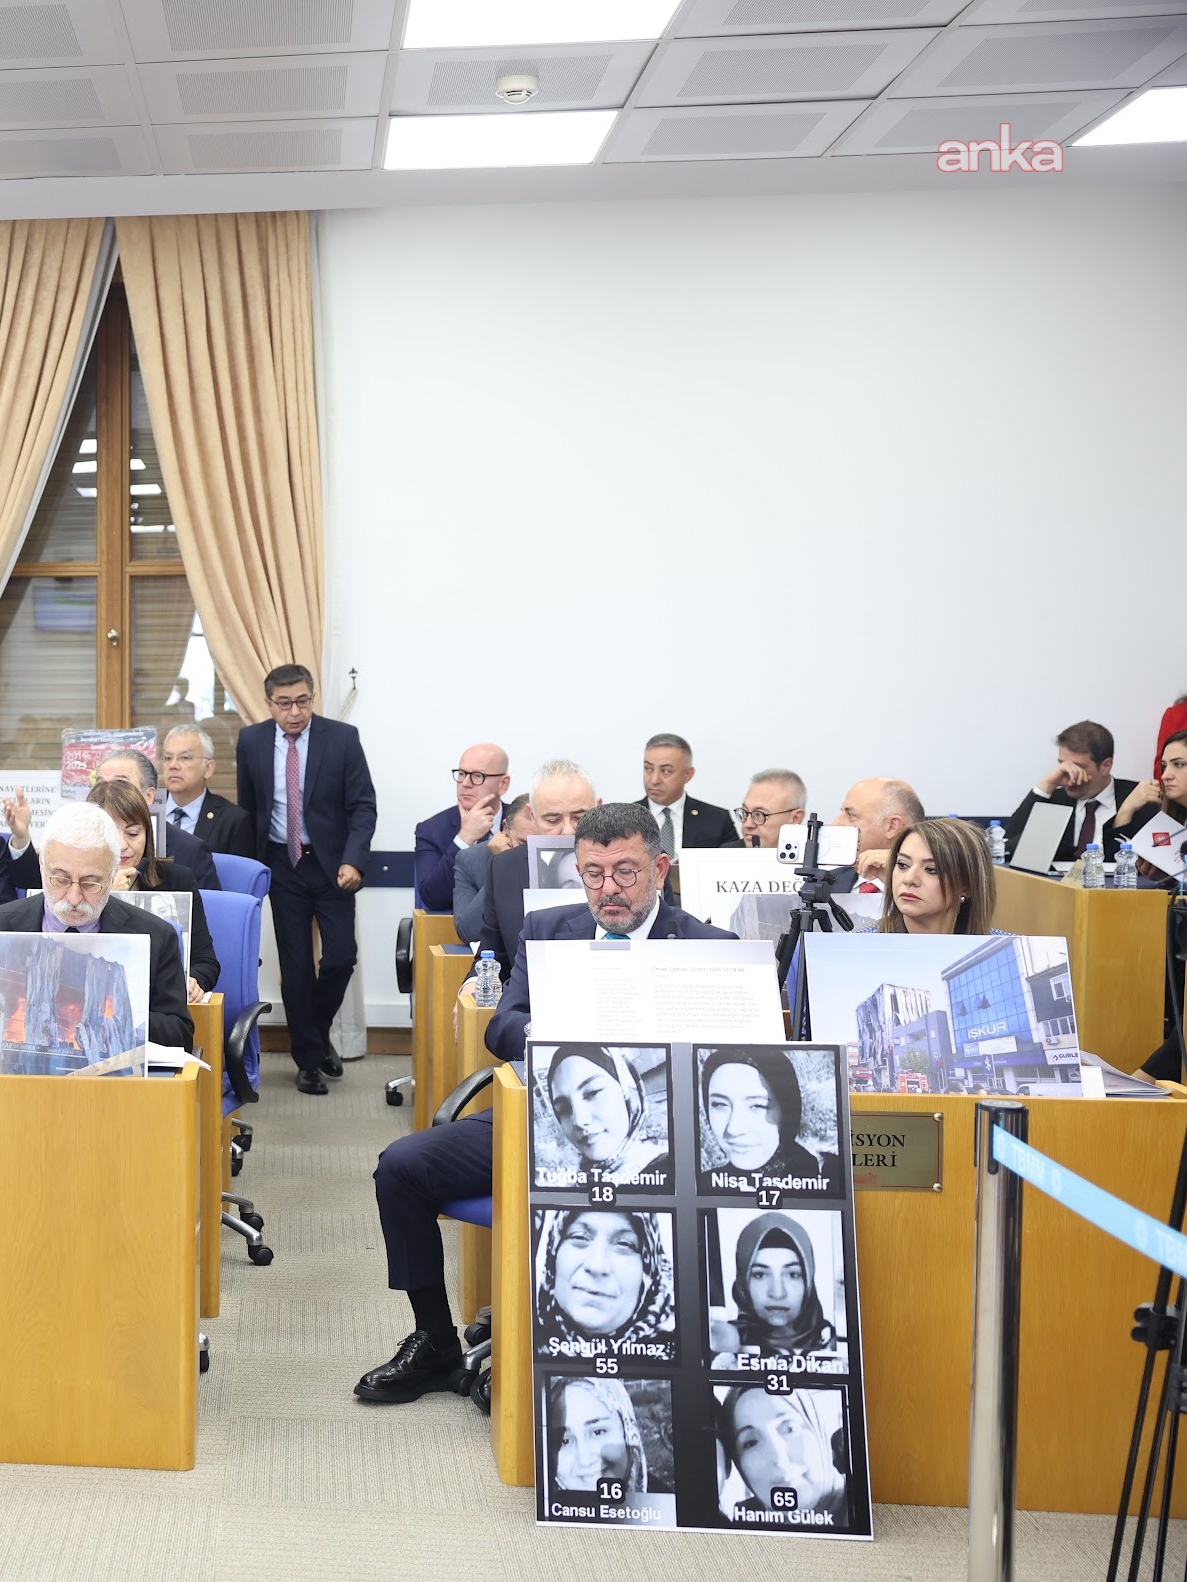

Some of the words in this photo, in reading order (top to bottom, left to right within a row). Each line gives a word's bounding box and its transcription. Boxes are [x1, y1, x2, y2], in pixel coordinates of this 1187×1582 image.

[716, 880, 763, 893] KAZA
[768, 877, 804, 893] DEĞ
[711, 1172, 748, 1188] Nisa
[591, 1186, 614, 1202] 18
[758, 1190, 781, 1206] 17
[548, 1337, 608, 1357] Şengül
[609, 1338, 666, 1357] Yılmaz
[595, 1358, 619, 1374] 55
[737, 1353, 788, 1371] Esma
[767, 1374, 791, 1391] 31
[599, 1482, 623, 1500] 16
[773, 1491, 796, 1507] 65
[551, 1503, 596, 1517] Cansu
[599, 1504, 662, 1522] Esetoğlu
[734, 1506, 785, 1523] Hanım
[787, 1509, 834, 1525] Gülek
